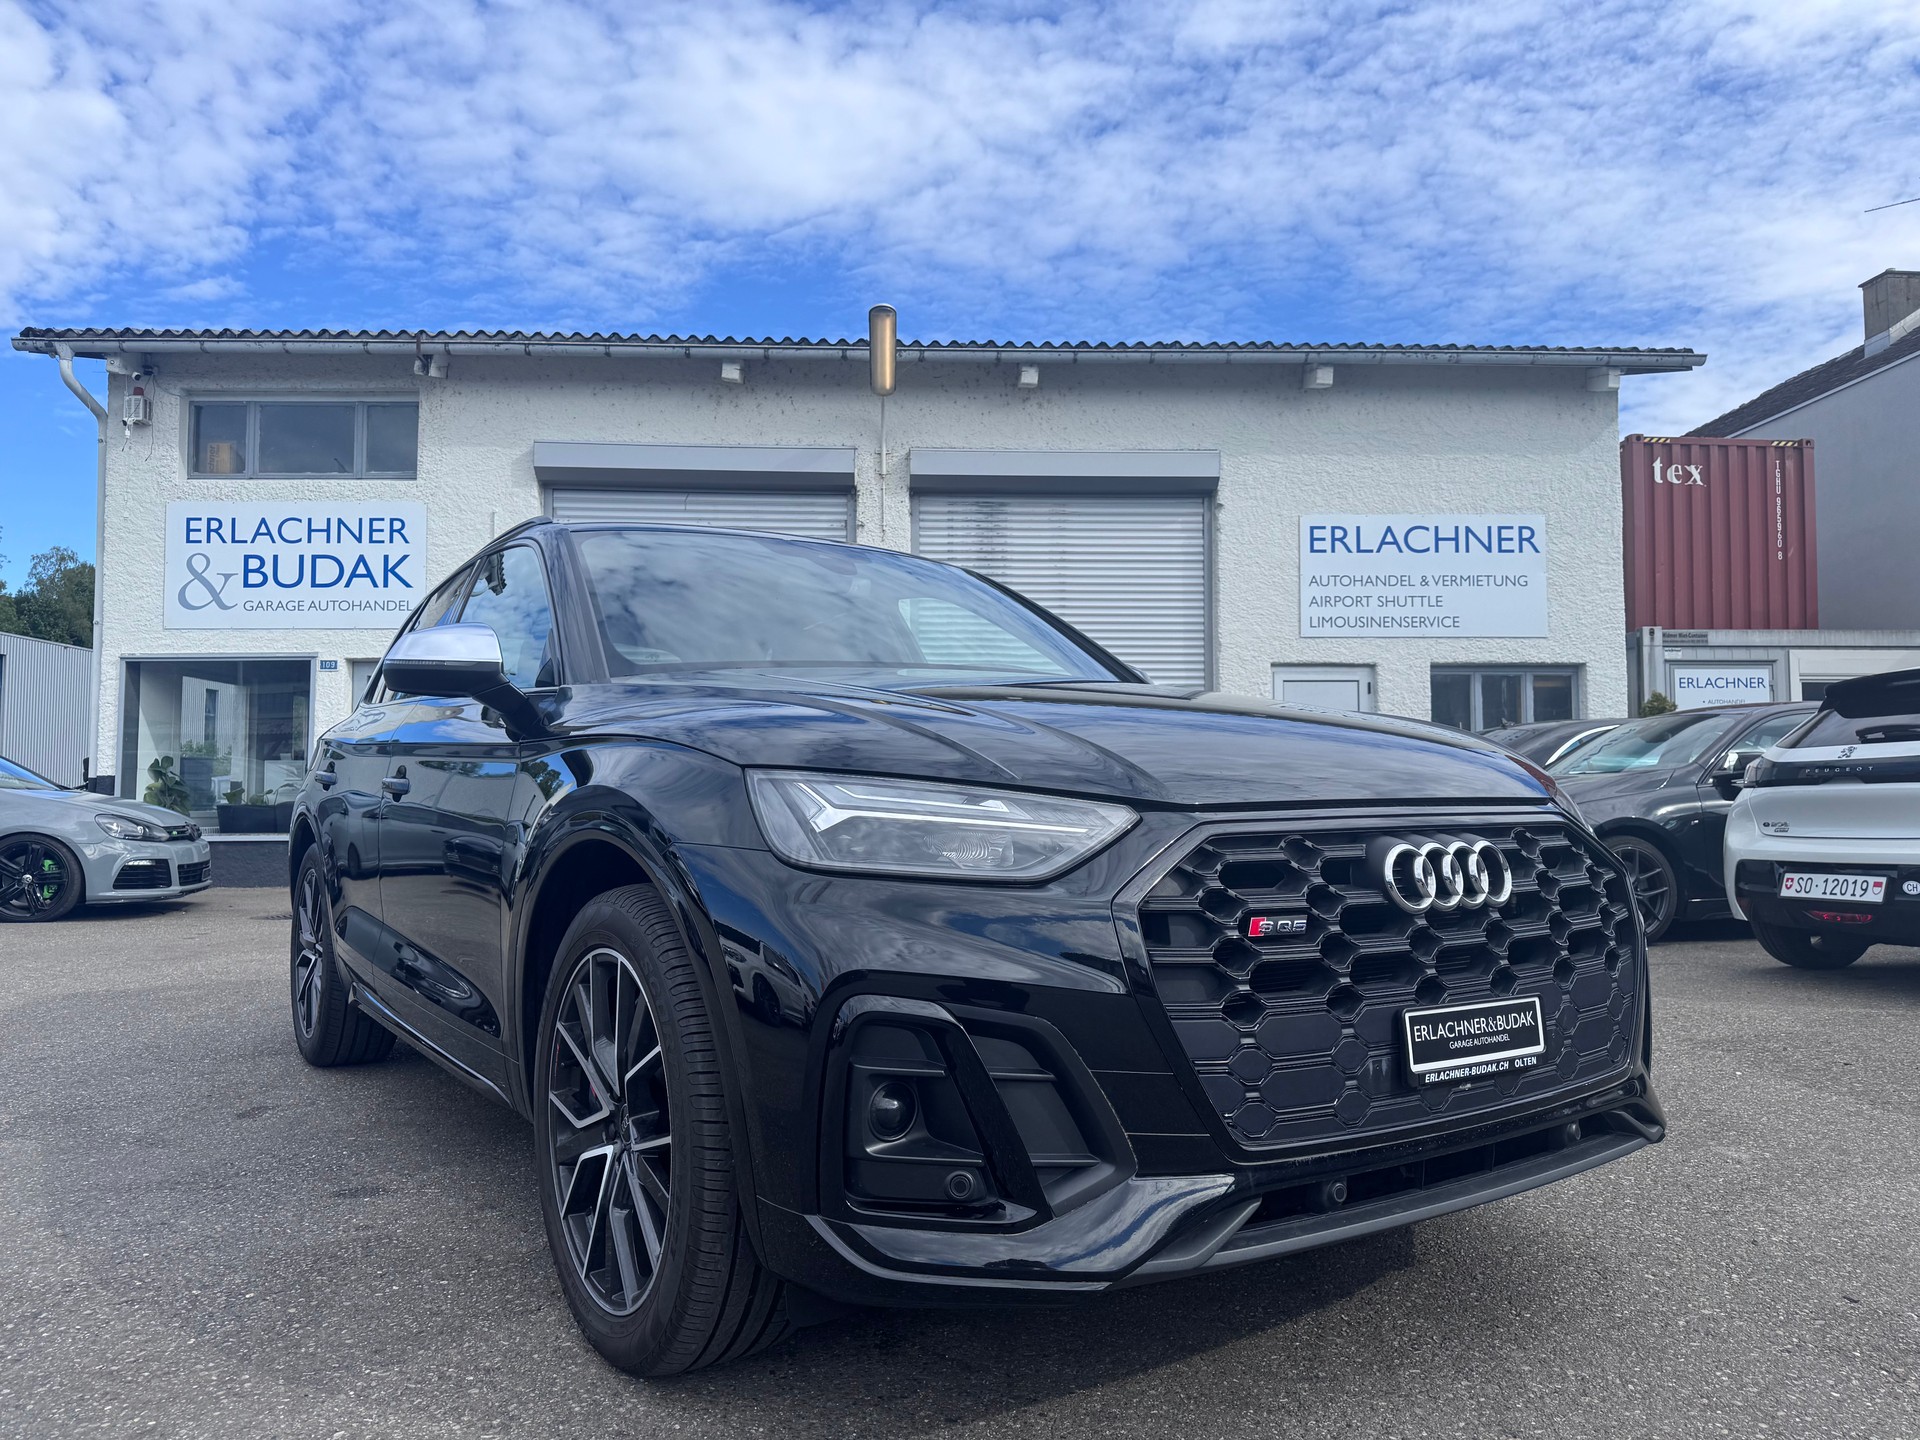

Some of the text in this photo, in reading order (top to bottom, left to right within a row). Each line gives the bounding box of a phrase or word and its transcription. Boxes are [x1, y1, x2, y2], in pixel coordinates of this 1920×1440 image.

[1652, 456, 1703, 485] tex
[185, 517, 410, 544] ERLACHNER
[1309, 525, 1541, 554] ERLACHNER
[177, 552, 413, 611] & BUDAK
[1309, 575, 1528, 587] AUTOHANDEL & VERMIETUNG
[243, 600, 413, 612] GARAGE AUTOHANDEL
[1309, 595, 1443, 608] AIRPORT SHUTTLE
[1309, 616, 1460, 628] LIMOUSINENSERVICE
[322, 661, 335, 669] 109
[1679, 677, 1766, 689] ERLACHNER
[1906, 883, 1918, 892] CH
[1449, 1033, 1510, 1050] GARAGE AUTOHANDEL
[1425, 1056, 1537, 1082] ERLACHNER-BUDAK.CH OLTEN
